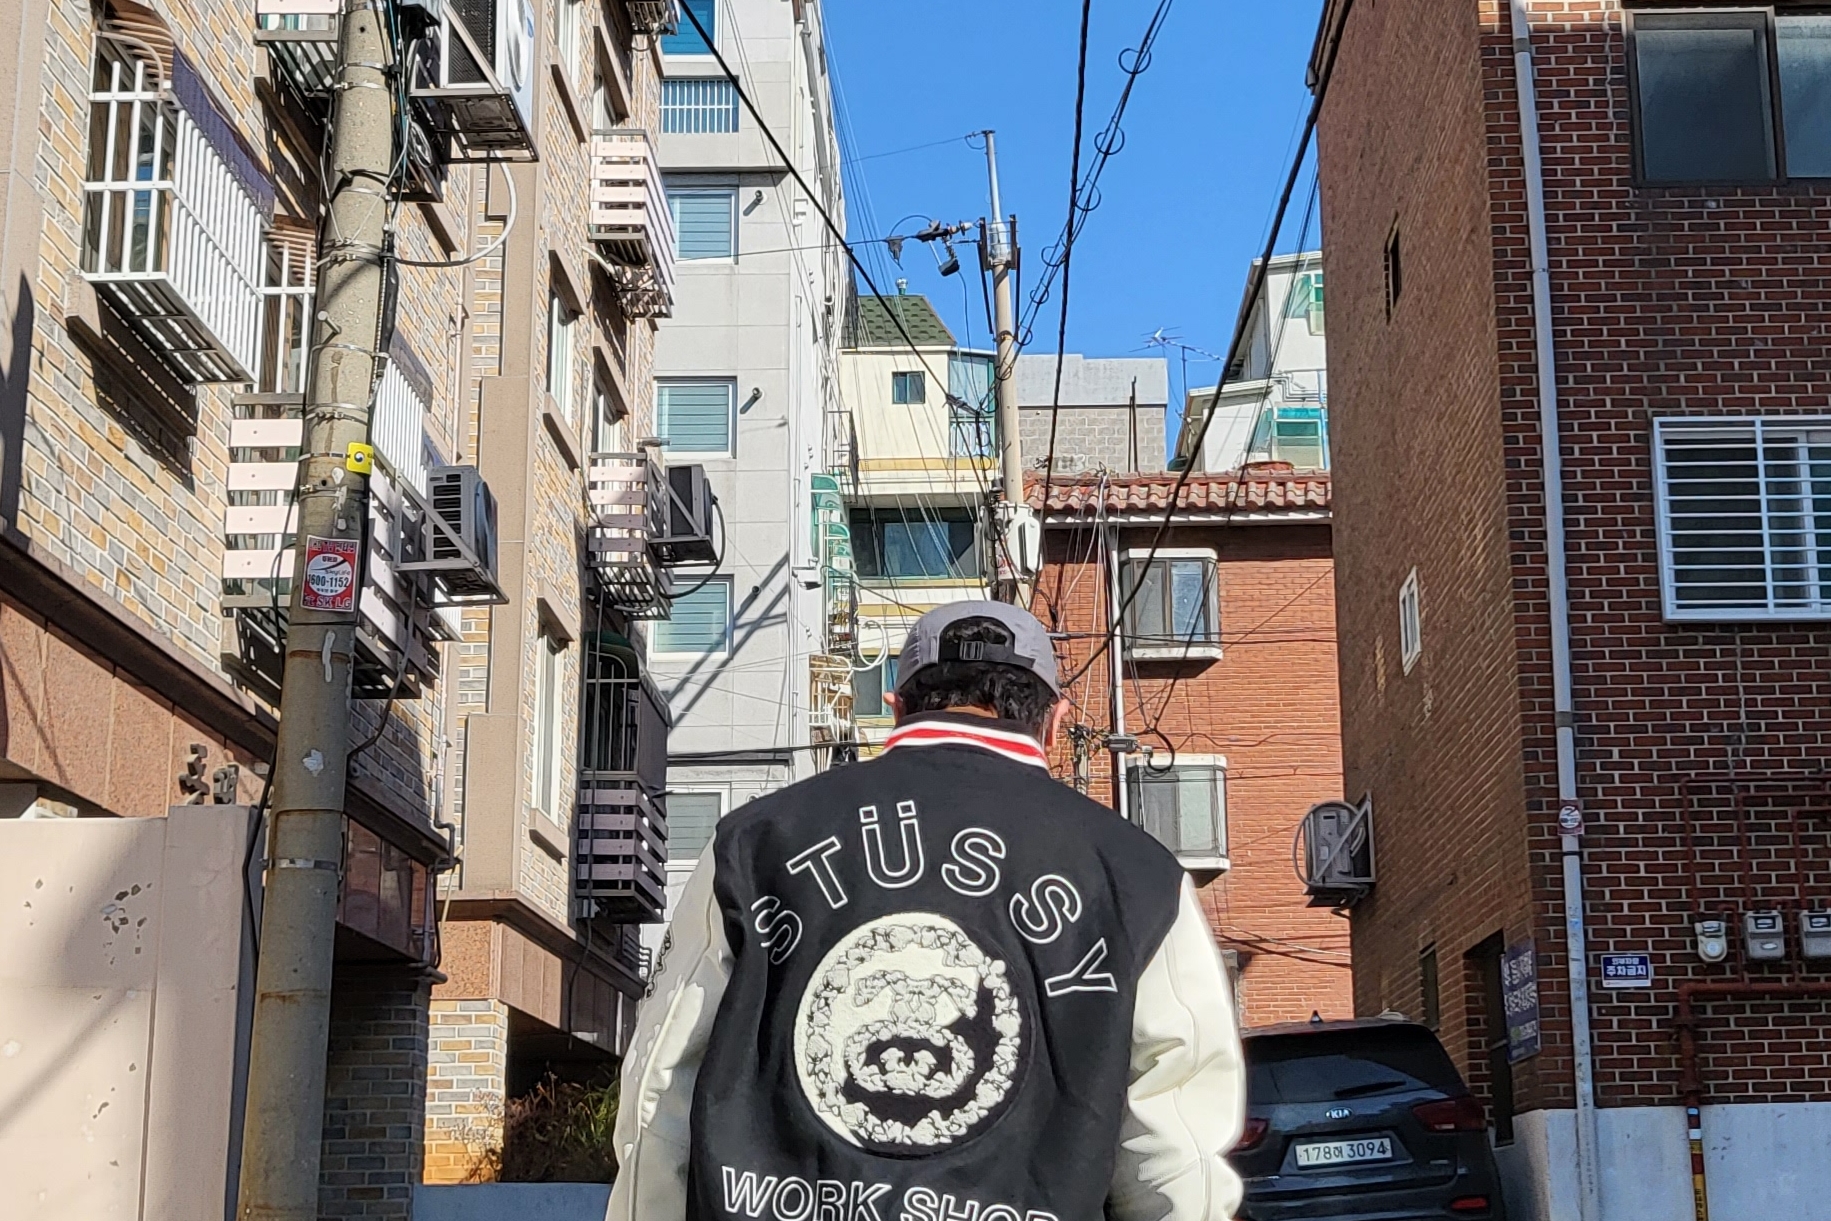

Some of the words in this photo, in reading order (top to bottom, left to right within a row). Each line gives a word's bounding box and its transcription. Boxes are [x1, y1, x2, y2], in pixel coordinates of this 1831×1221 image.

[308, 574, 350, 588] 1600-1152
[316, 595, 332, 608] SK
[335, 596, 351, 609] LG
[750, 799, 1118, 998] STÜSSY
[1606, 965, 1647, 976] 주차금지
[1346, 1140, 1387, 1159] 3094
